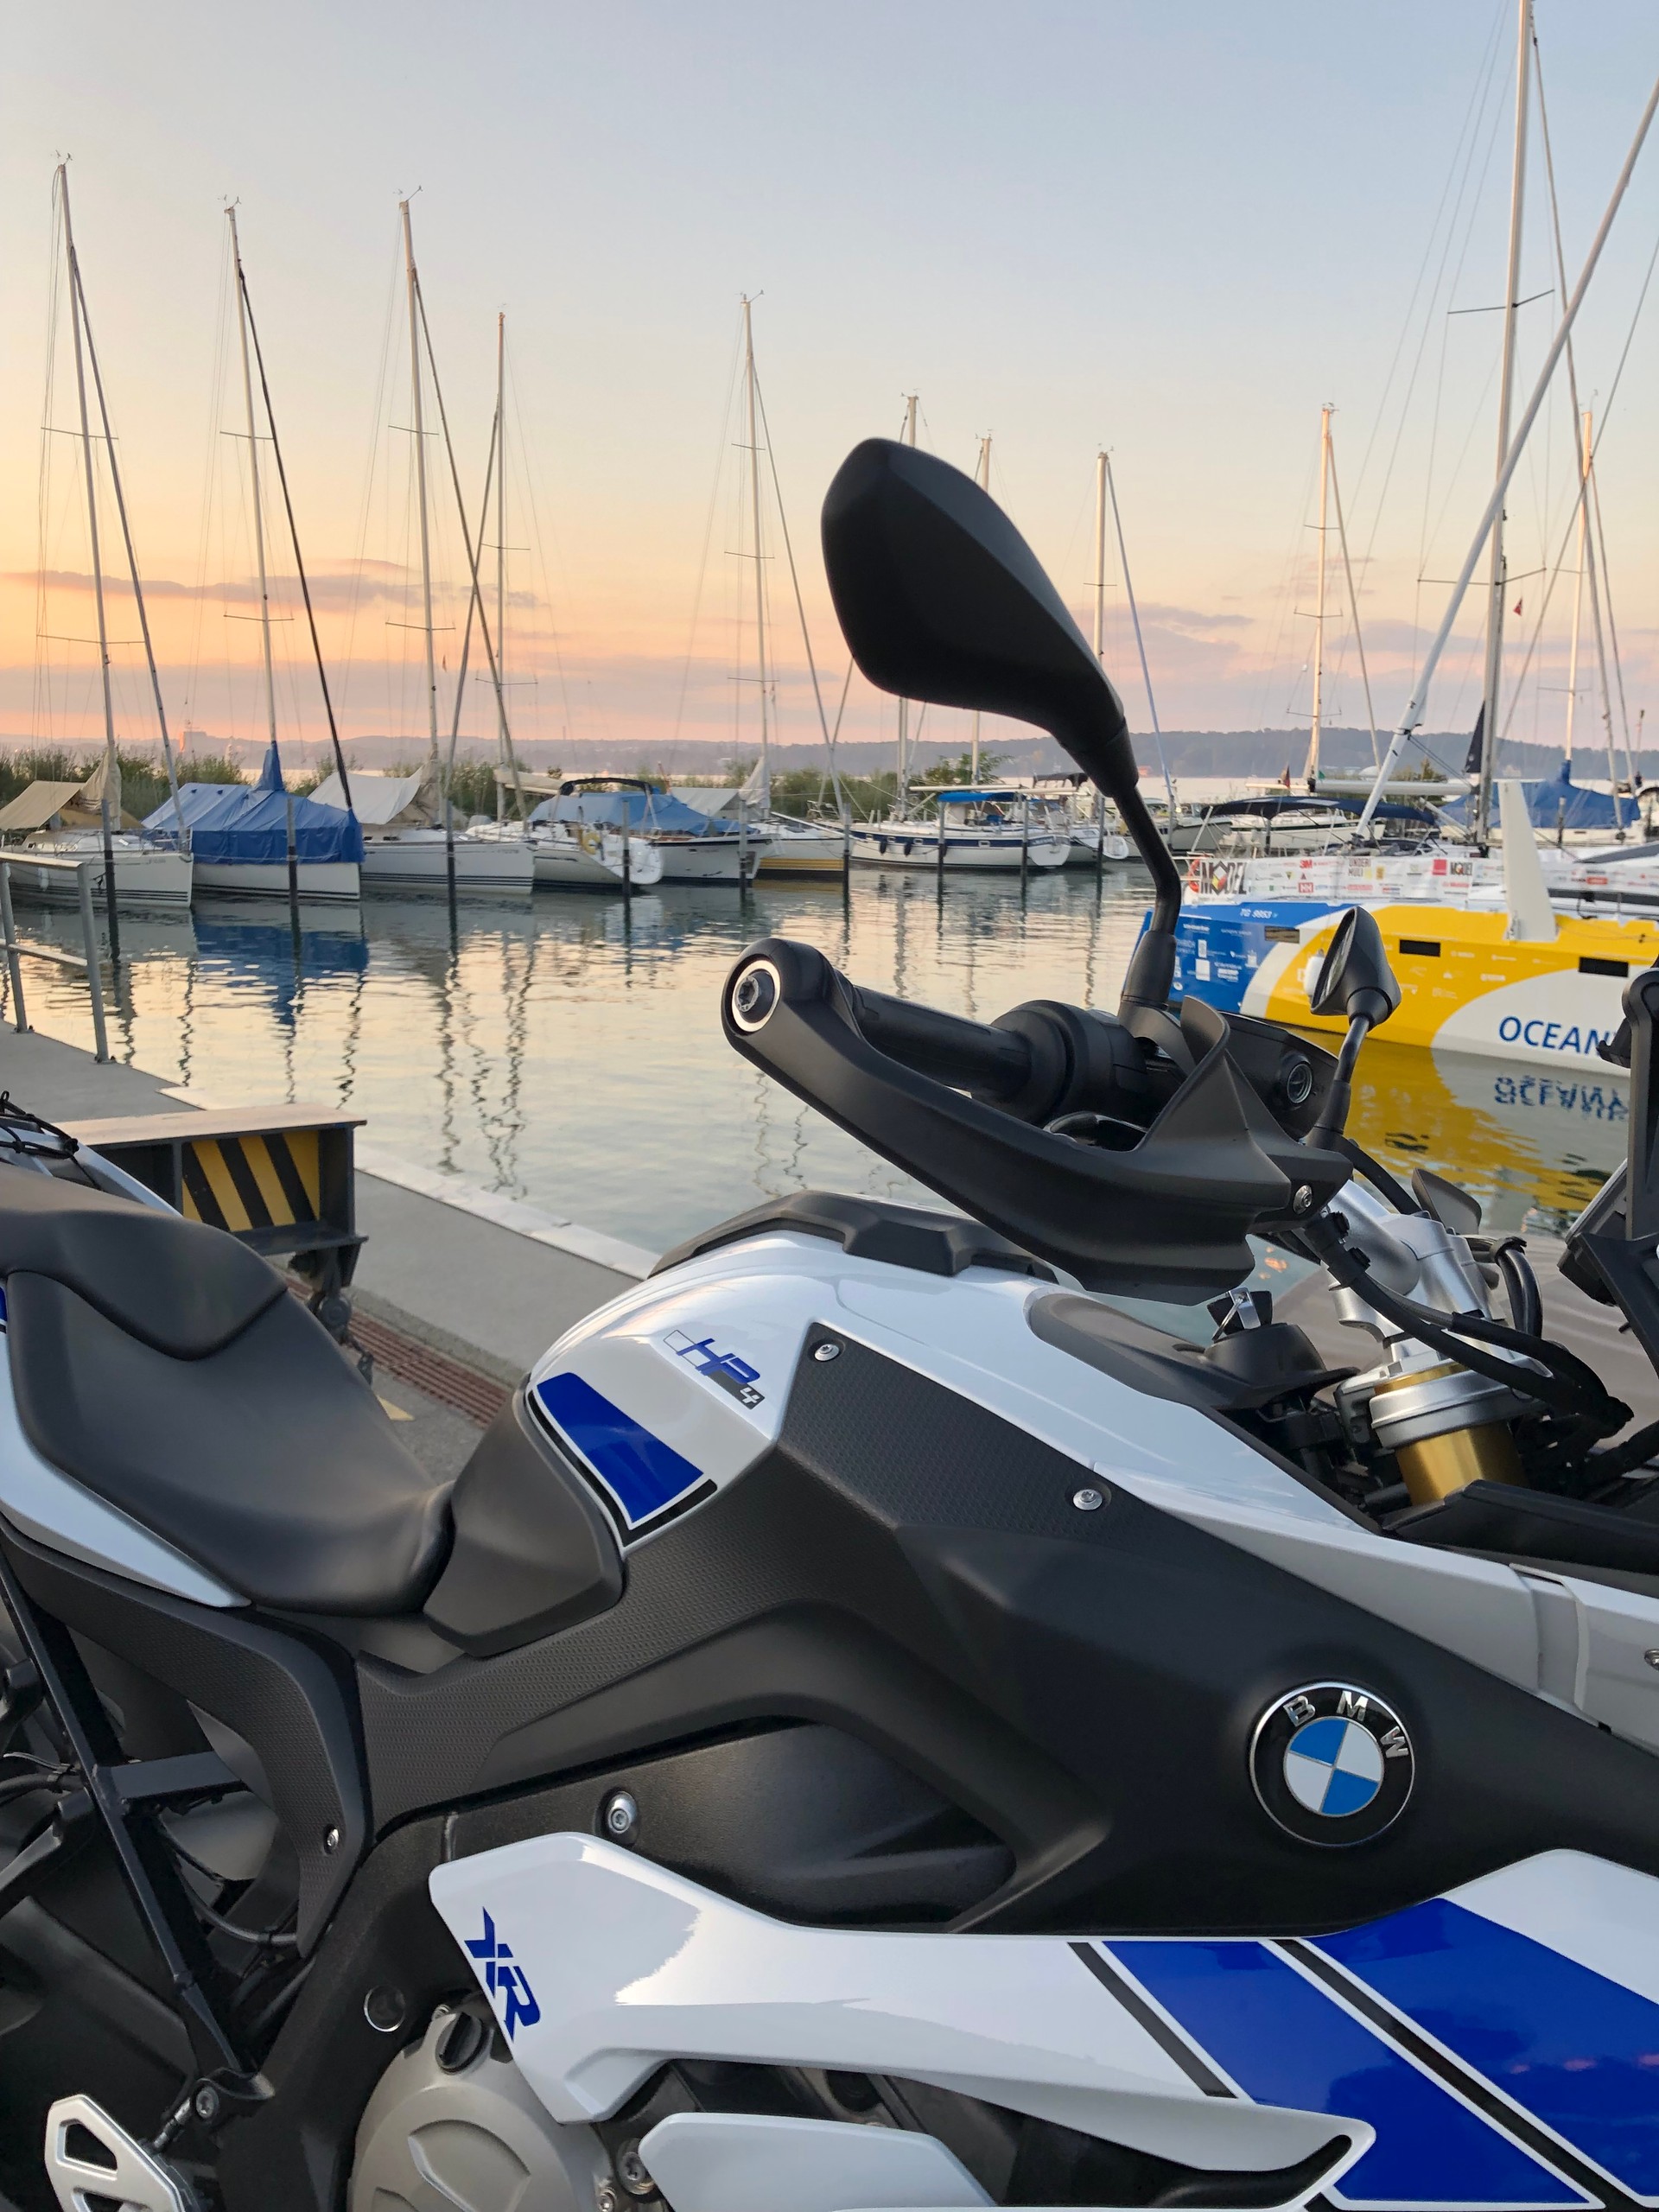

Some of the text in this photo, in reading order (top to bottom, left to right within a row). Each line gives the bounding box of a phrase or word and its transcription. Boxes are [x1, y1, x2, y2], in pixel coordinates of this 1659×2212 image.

[1300, 859, 1313, 869] 3M
[1498, 1015, 1616, 1056] OCEAN
[1283, 1690, 1409, 1758] BMW
[464, 1906, 541, 2043] XR
